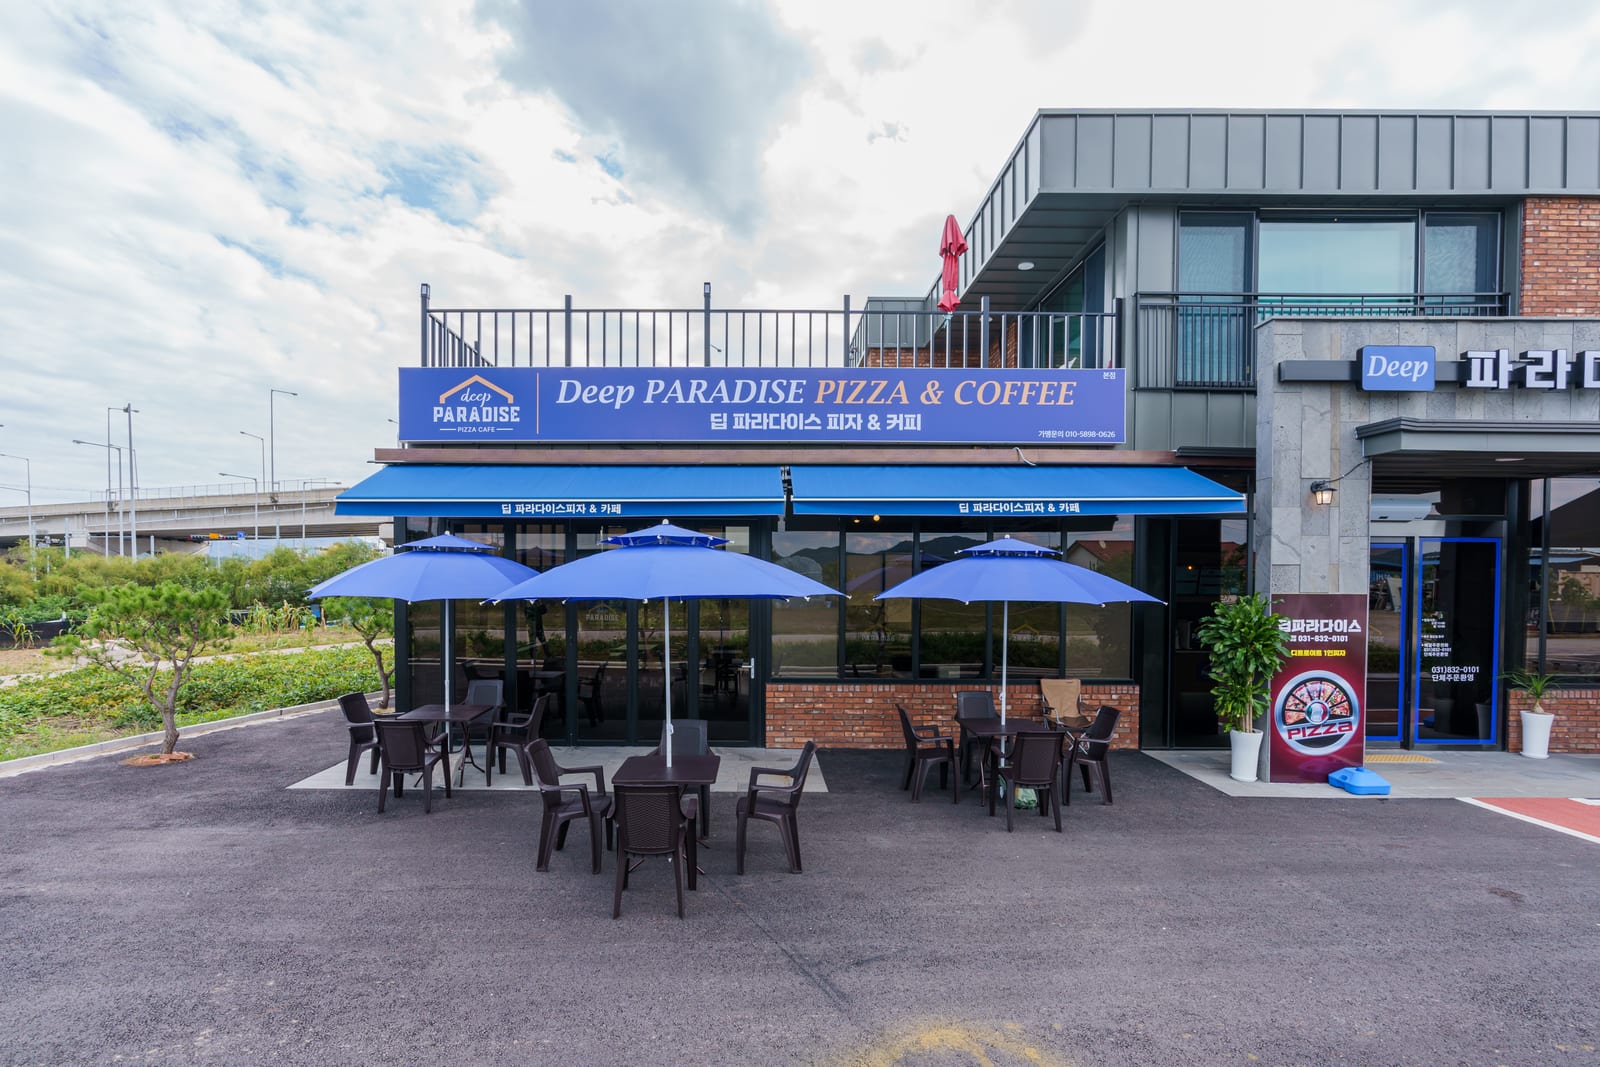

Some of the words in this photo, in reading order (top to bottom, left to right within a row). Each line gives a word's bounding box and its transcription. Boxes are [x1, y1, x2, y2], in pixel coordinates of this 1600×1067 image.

[1367, 356, 1429, 382] Deep
[1103, 371, 1116, 380] 본점
[460, 387, 492, 407] deep
[556, 379, 635, 409] Deep
[643, 379, 806, 405] PARADISE
[814, 379, 910, 405] PIZZA
[919, 380, 945, 405] &
[954, 380, 1077, 406] COFFEE
[433, 406, 520, 422] PARADISE
[710, 412, 728, 431] 딥
[732, 412, 822, 430] 파라다이스
[826, 412, 863, 431] 피자
[867, 413, 881, 431] &
[886, 413, 921, 431] 커피
[1038, 430, 1064, 439] 가맹문의
[501, 503, 512, 515] 딥
[515, 503, 587, 514] 파라다이스피자
[589, 504, 598, 514] &
[600, 503, 621, 514] 카페
[959, 502, 969, 513] 딥
[973, 502, 1045, 513] 파라다이스피자
[1047, 503, 1056, 512] &
[1059, 502, 1080, 513] 카페
[1431, 666, 1480, 674] 031)832-0101
[1431, 674, 1474, 682] 단체주문환영
